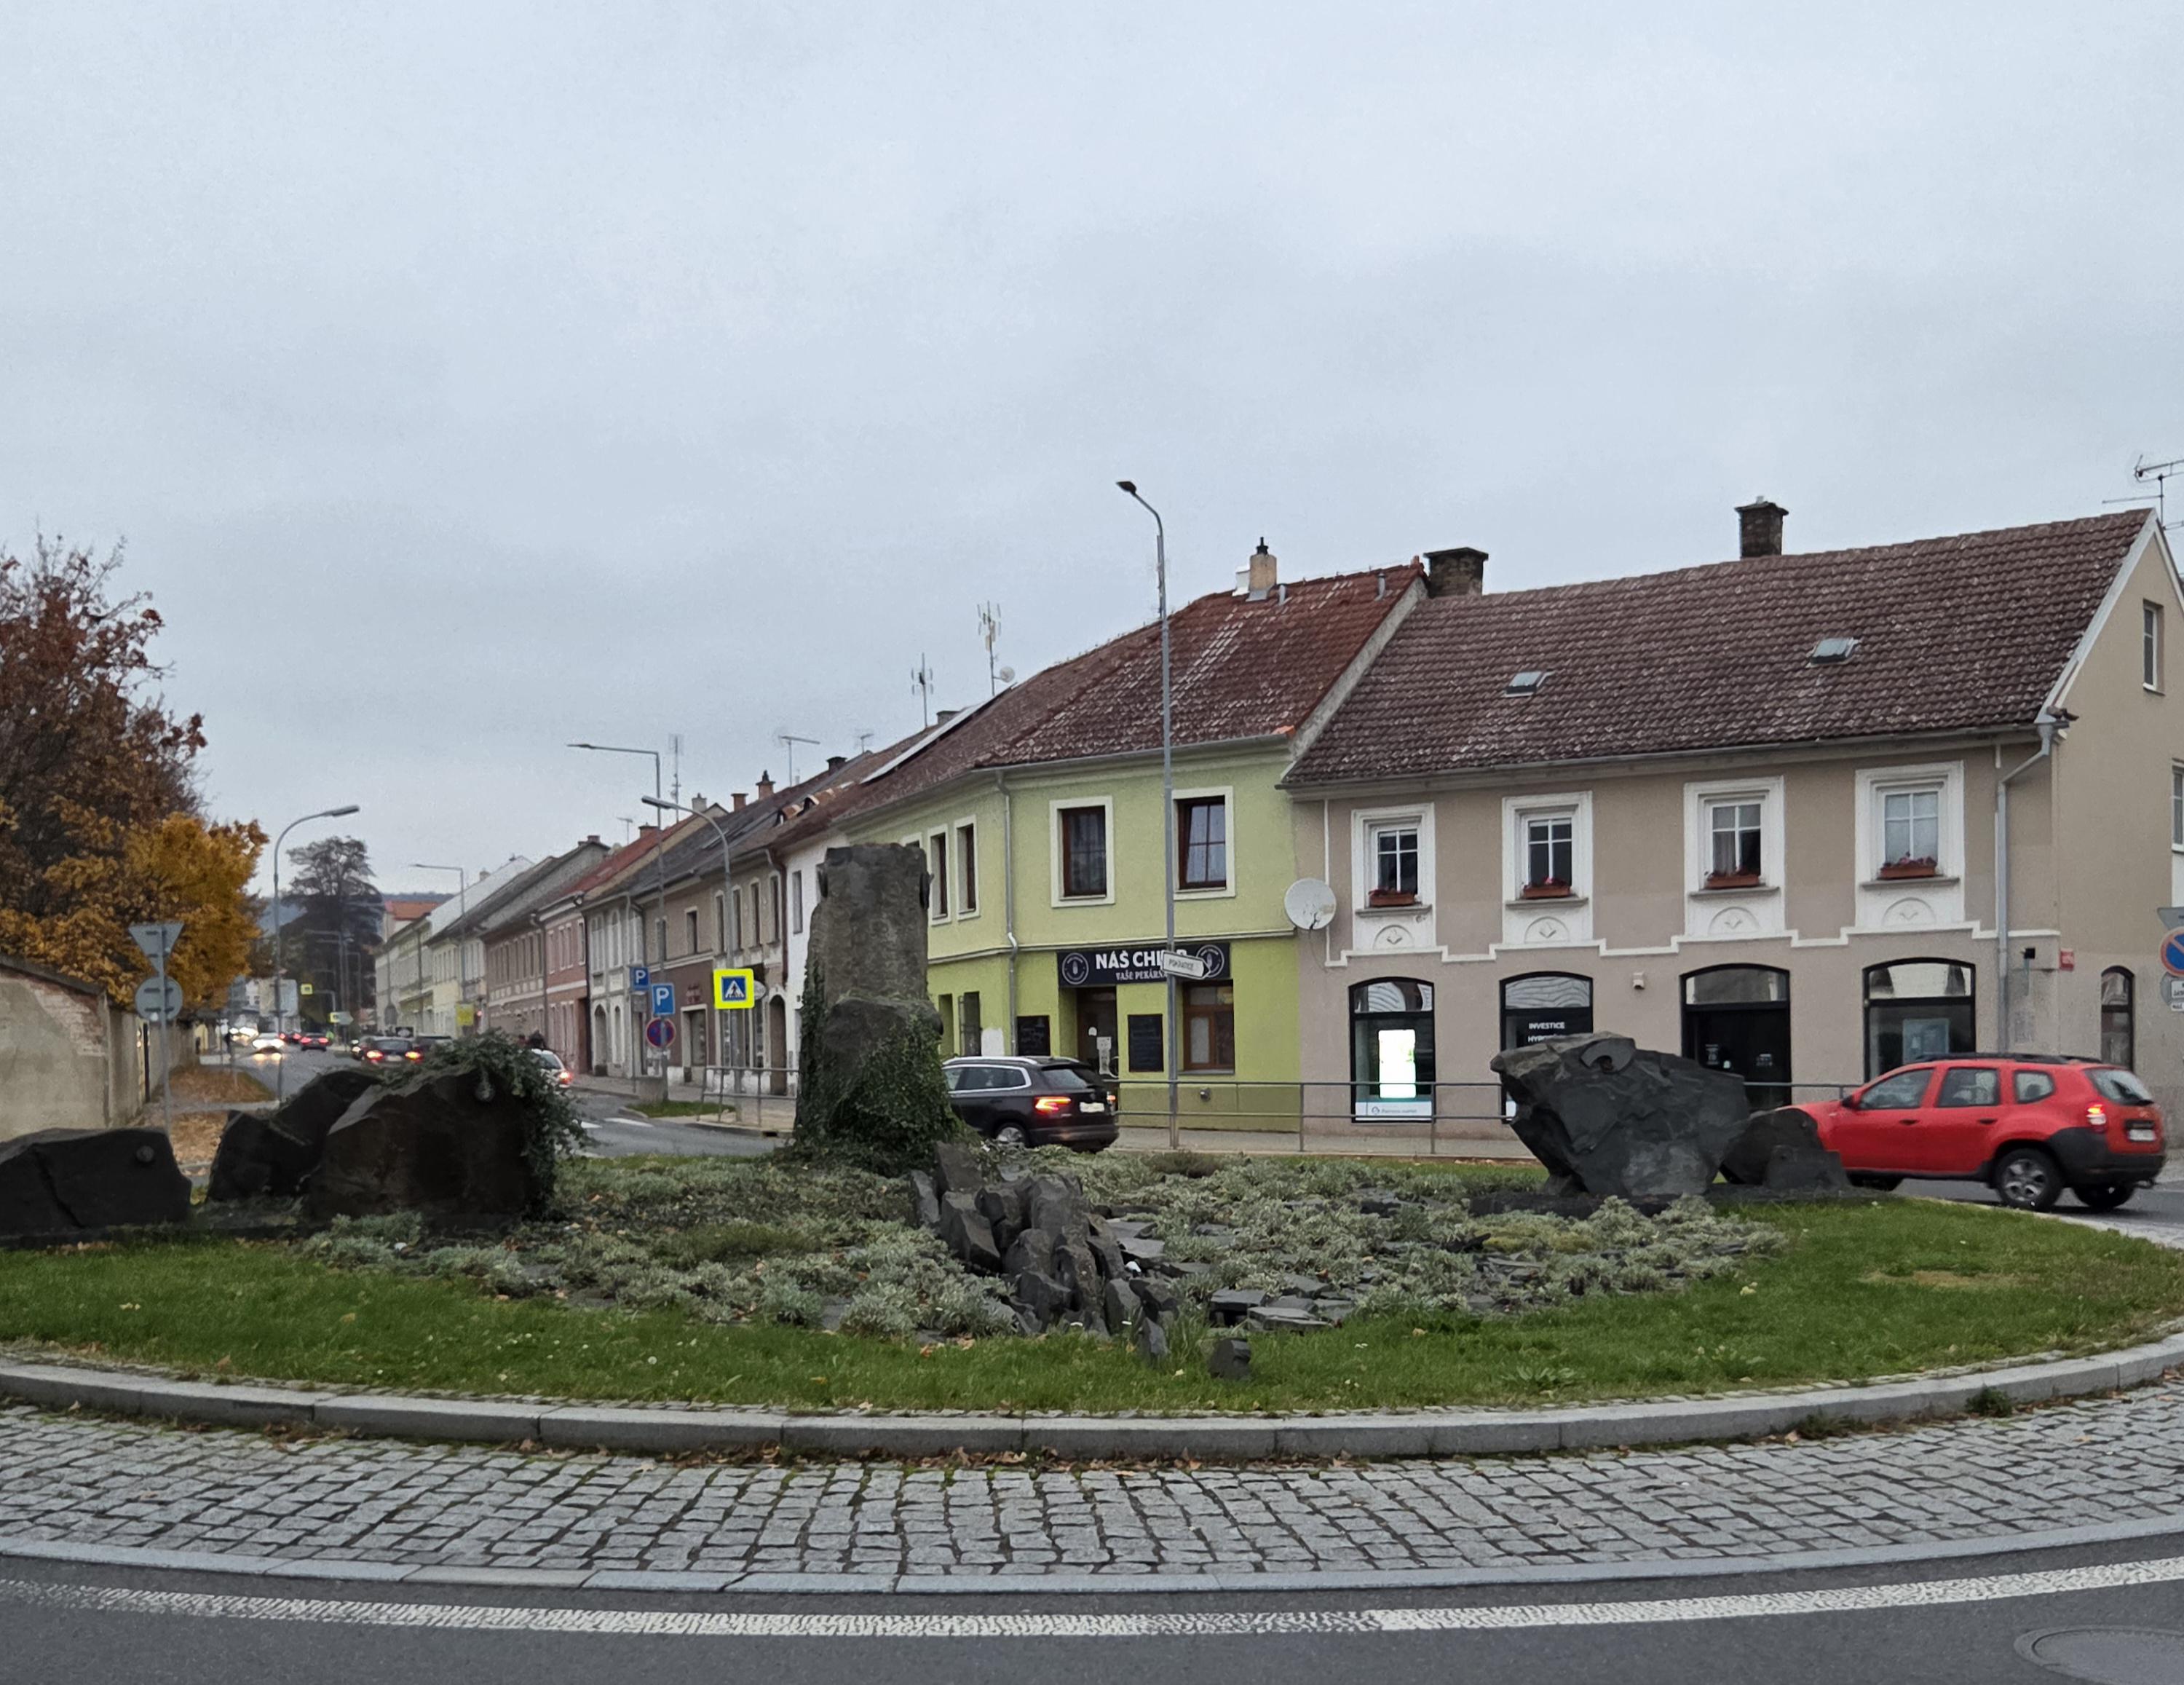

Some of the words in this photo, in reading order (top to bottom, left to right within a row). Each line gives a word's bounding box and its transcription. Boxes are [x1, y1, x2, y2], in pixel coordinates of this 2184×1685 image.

[1096, 950, 1130, 969] NÁŠ
[636, 970, 646, 984] P
[657, 987, 669, 1006] P
[1529, 1022, 1565, 1030] INVESTICE
